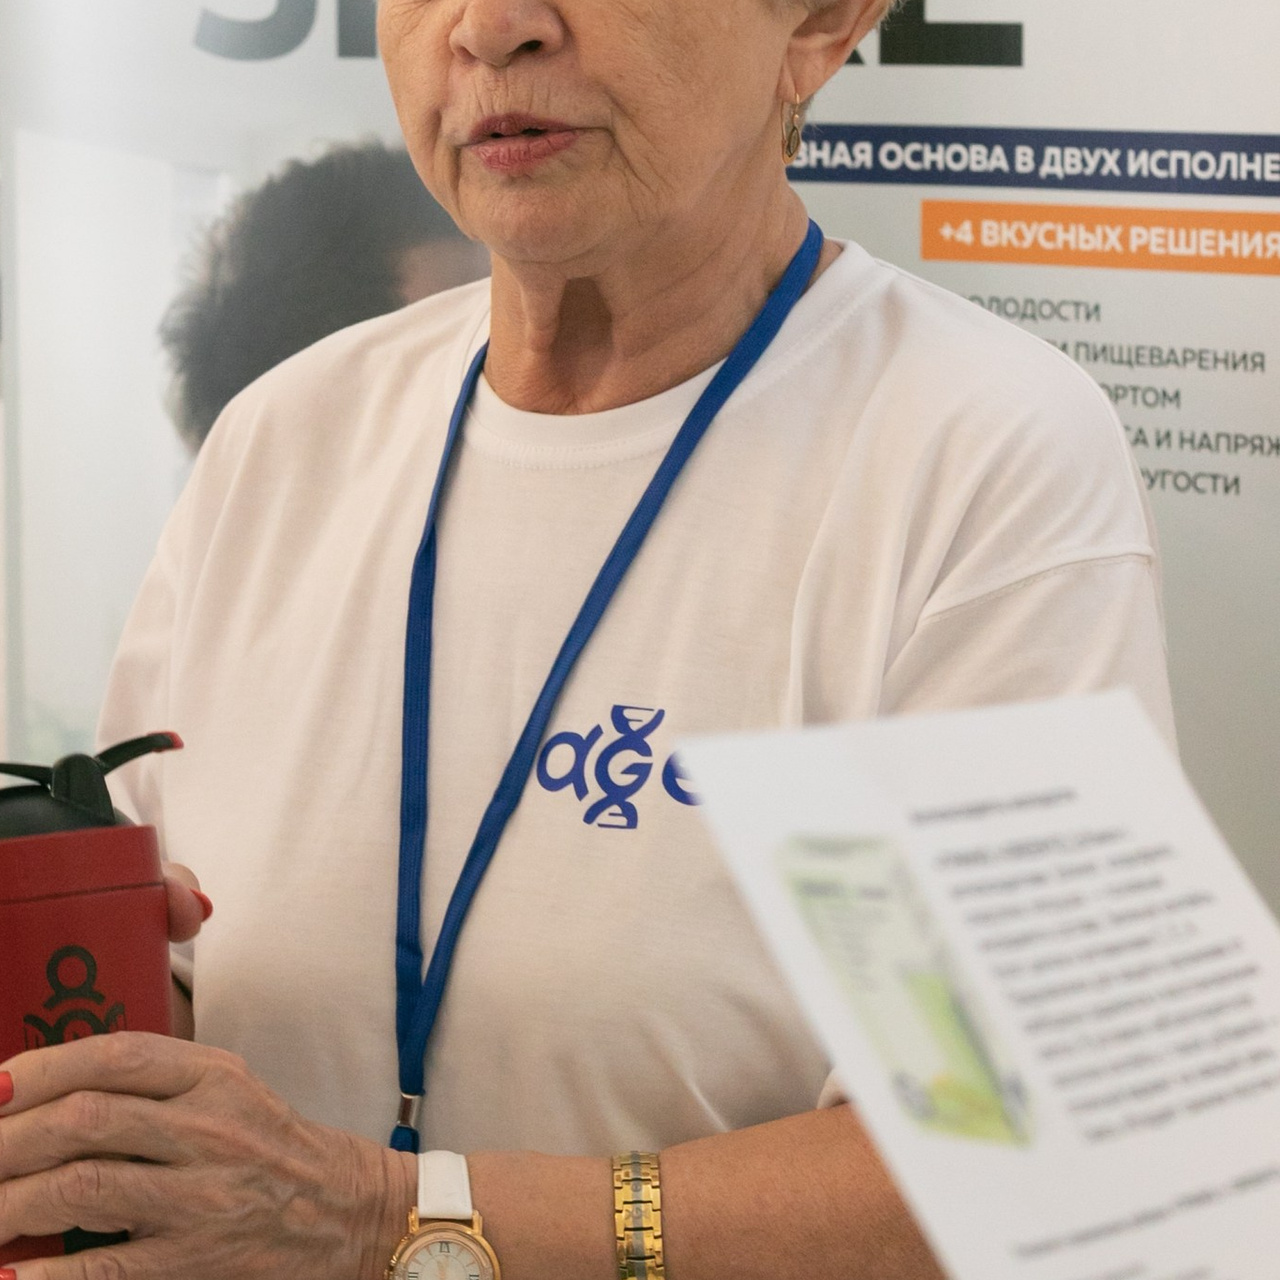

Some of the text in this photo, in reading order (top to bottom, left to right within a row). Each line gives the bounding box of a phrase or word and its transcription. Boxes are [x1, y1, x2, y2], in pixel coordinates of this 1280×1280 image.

[878, 141, 1009, 173] ОСНОВА
[1015, 145, 1035, 174] В
[1040, 146, 1120, 180] ДВУХ
[939, 219, 1280, 259] +4 ВКУСНЫХ РЕШЕНИЯ
[1074, 341, 1266, 373] ПИЩЕВАРЕНИЯ
